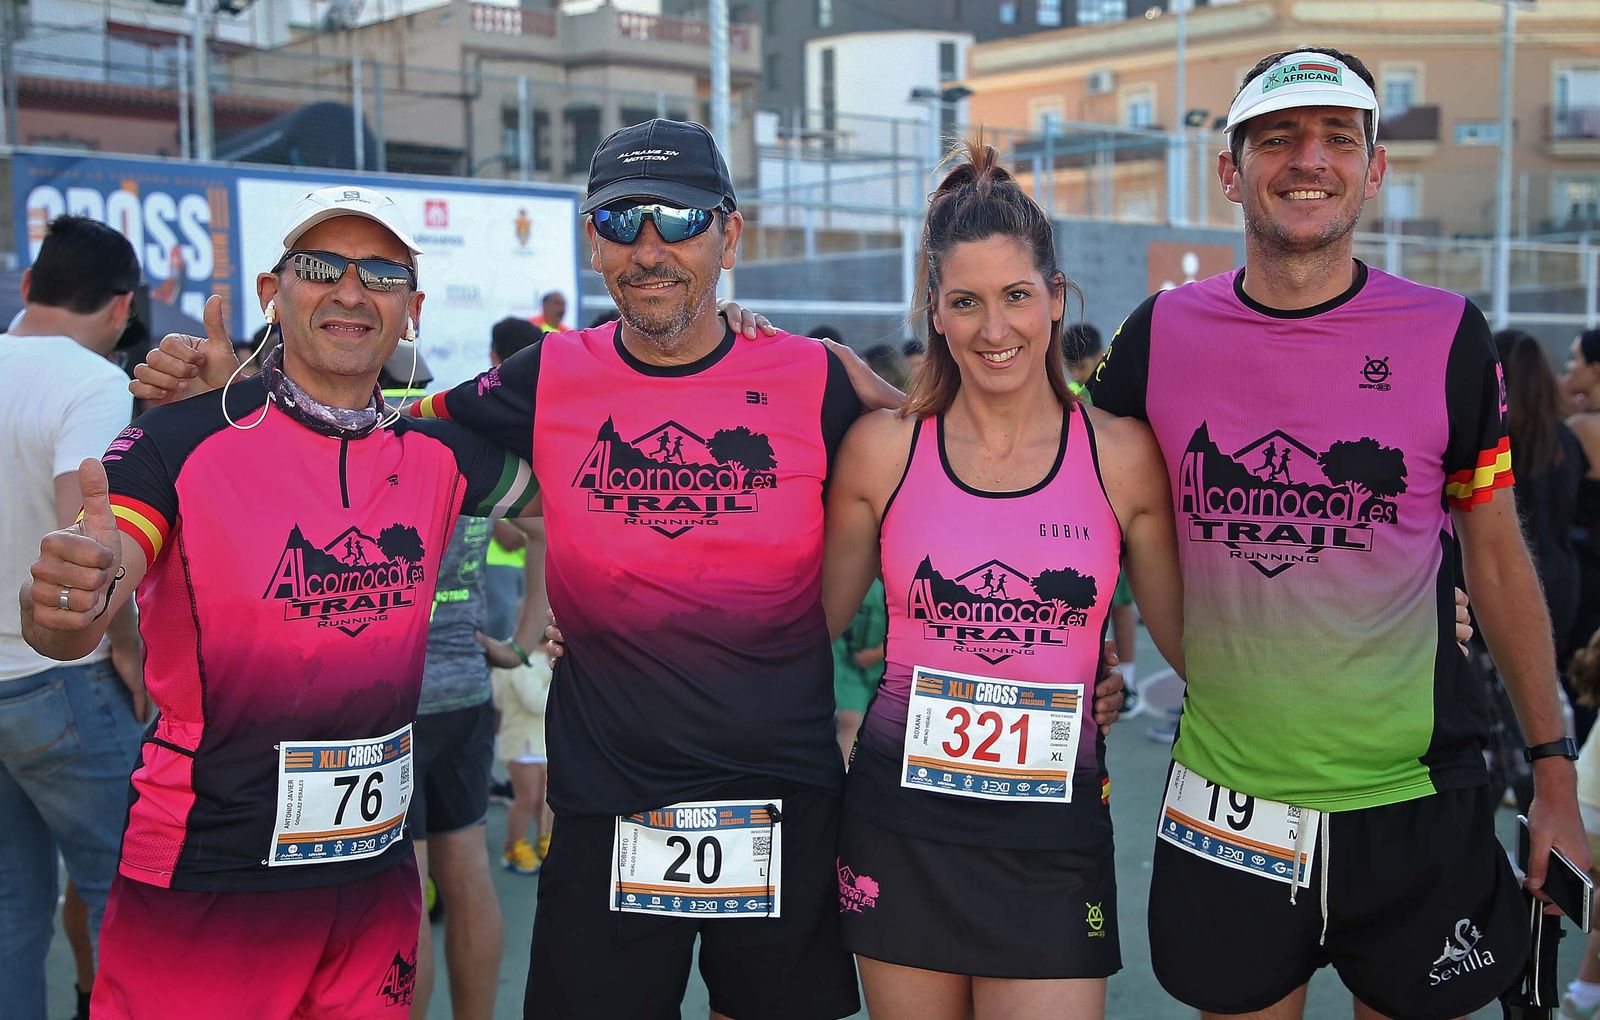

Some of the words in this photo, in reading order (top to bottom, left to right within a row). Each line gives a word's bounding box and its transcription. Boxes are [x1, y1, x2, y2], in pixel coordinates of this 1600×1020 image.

[1282, 73, 1339, 84] AFRICANA
[1283, 66, 1297, 74] LA
[622, 155, 669, 164] MOTION
[594, 495, 753, 511] TRAIL
[623, 517, 720, 526] RUNNING
[1039, 523, 1091, 541] GOBIK
[1192, 521, 1366, 549] TRAIL
[1229, 550, 1320, 564] RUNNING
[292, 591, 412, 617] TRAIL
[317, 614, 389, 628] RUNNING
[928, 625, 1063, 644] TRAIL
[953, 645, 1036, 656] RUNNING
[947, 680, 975, 700] XLII
[975, 682, 1019, 706] CROSS
[913, 714, 921, 740] ROXANA
[942, 706, 1030, 765] 321
[318, 750, 347, 768] XLII
[347, 743, 384, 767] CROSS
[1050, 752, 1063, 762] XL
[333, 770, 384, 826] 76
[399, 794, 408, 805] M
[1204, 779, 1255, 832] 19
[284, 802, 293, 829] ANTONIO
[648, 811, 674, 828] XLII
[675, 808, 717, 829] CROSS
[620, 838, 629, 867] ROBERTO
[663, 835, 723, 885] 20
[759, 867, 766, 877] L
[1428, 948, 1496, 986] Sevilla
